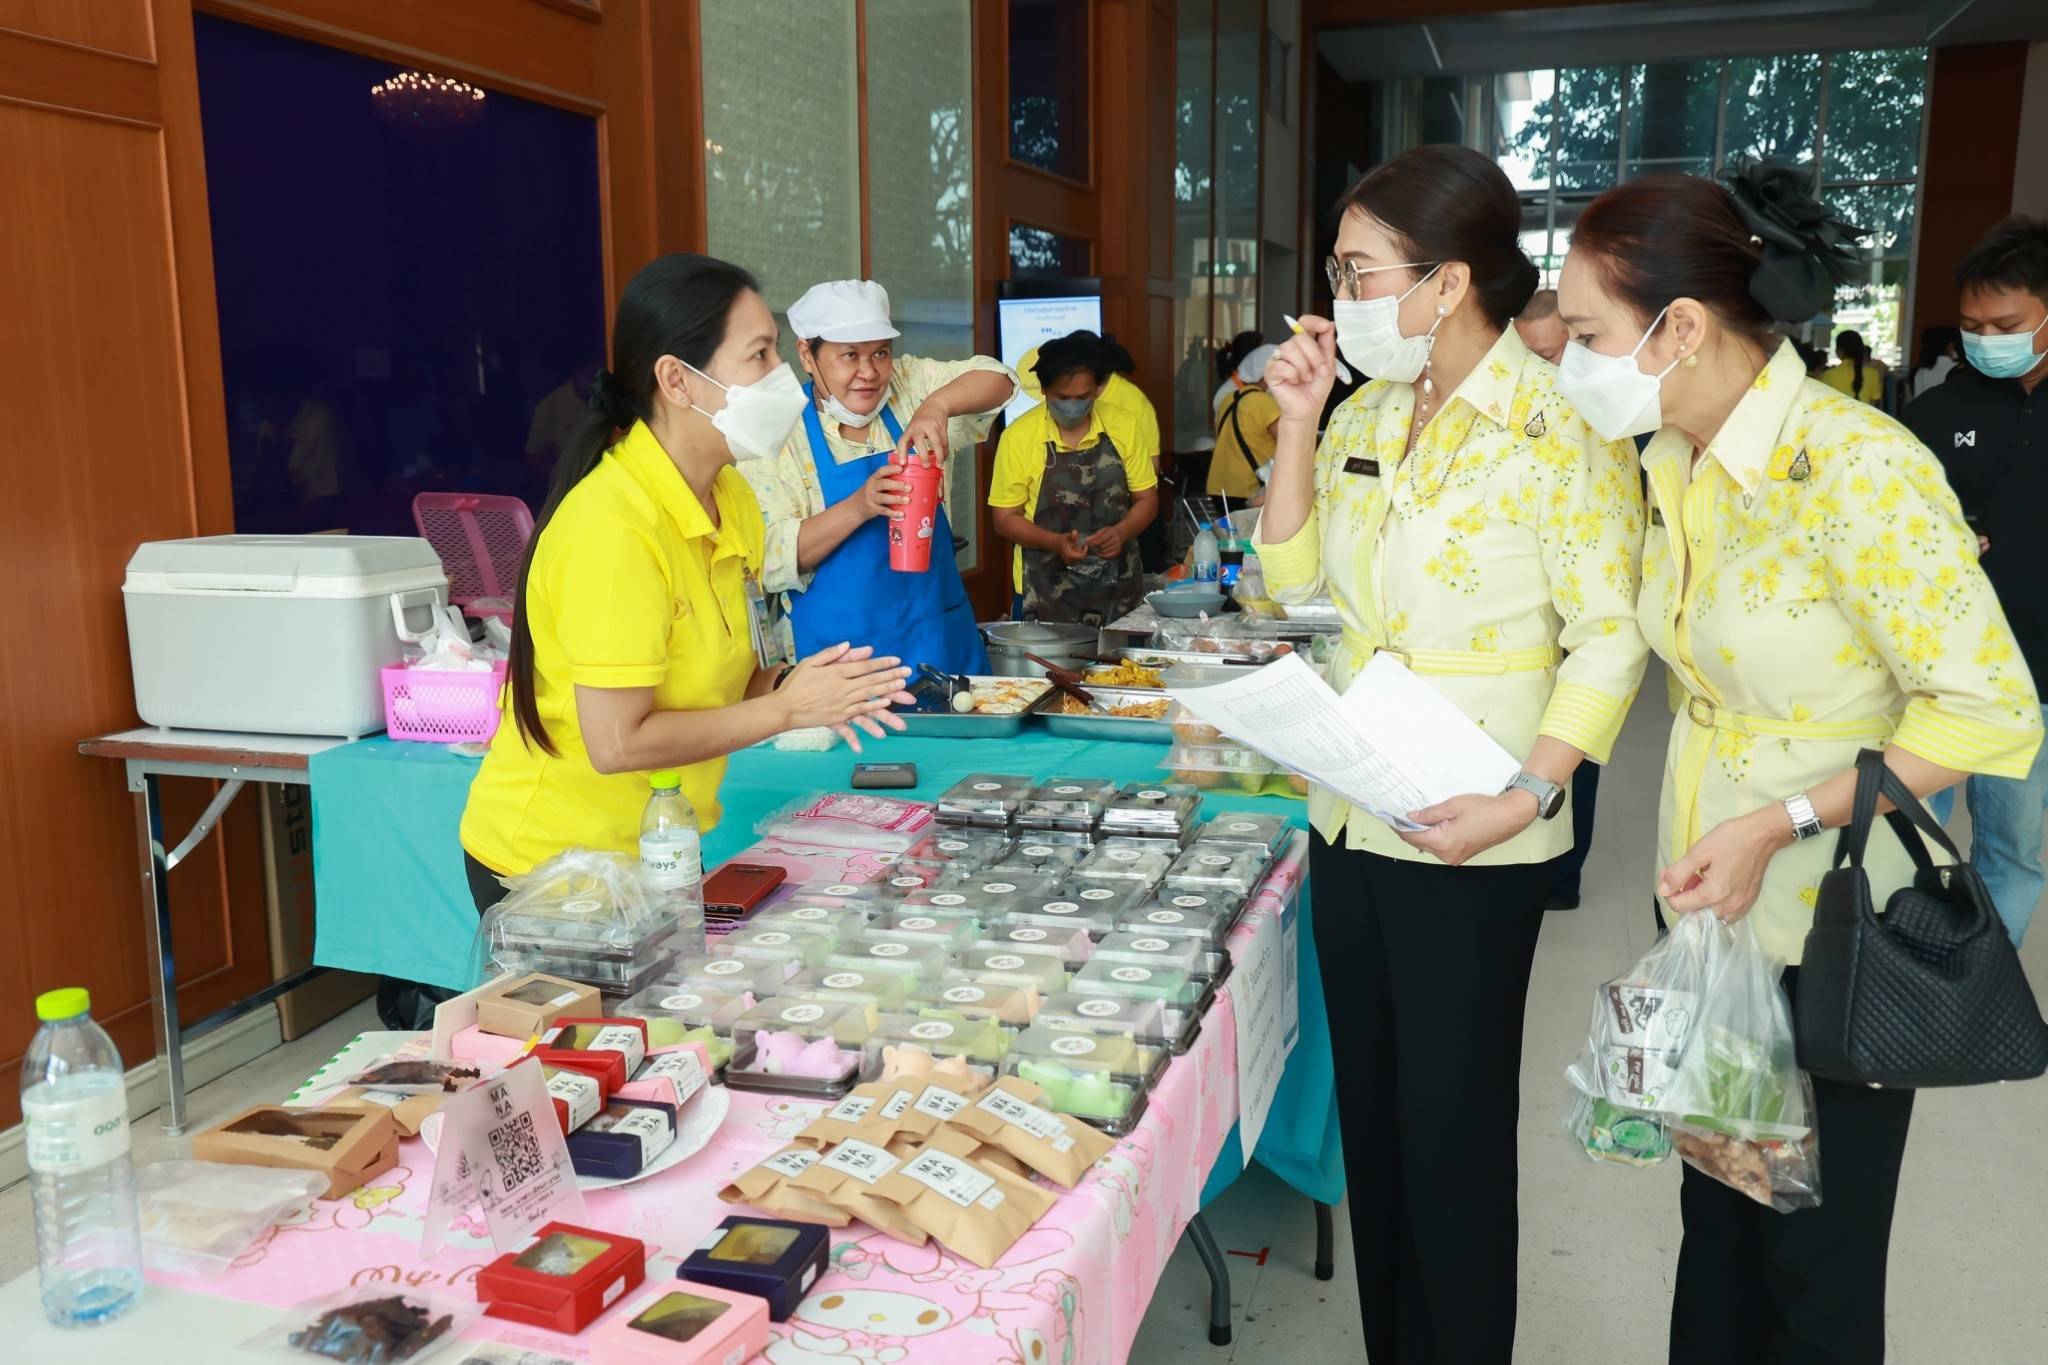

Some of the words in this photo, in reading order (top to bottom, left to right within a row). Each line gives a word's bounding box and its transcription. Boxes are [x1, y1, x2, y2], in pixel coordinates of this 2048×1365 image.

[490, 1087, 509, 1104] MA
[495, 1100, 512, 1116] NA
[837, 1149, 860, 1163] MA
[851, 1153, 874, 1168] NA
[917, 1159, 942, 1174] MA
[931, 1165, 956, 1180] NA
